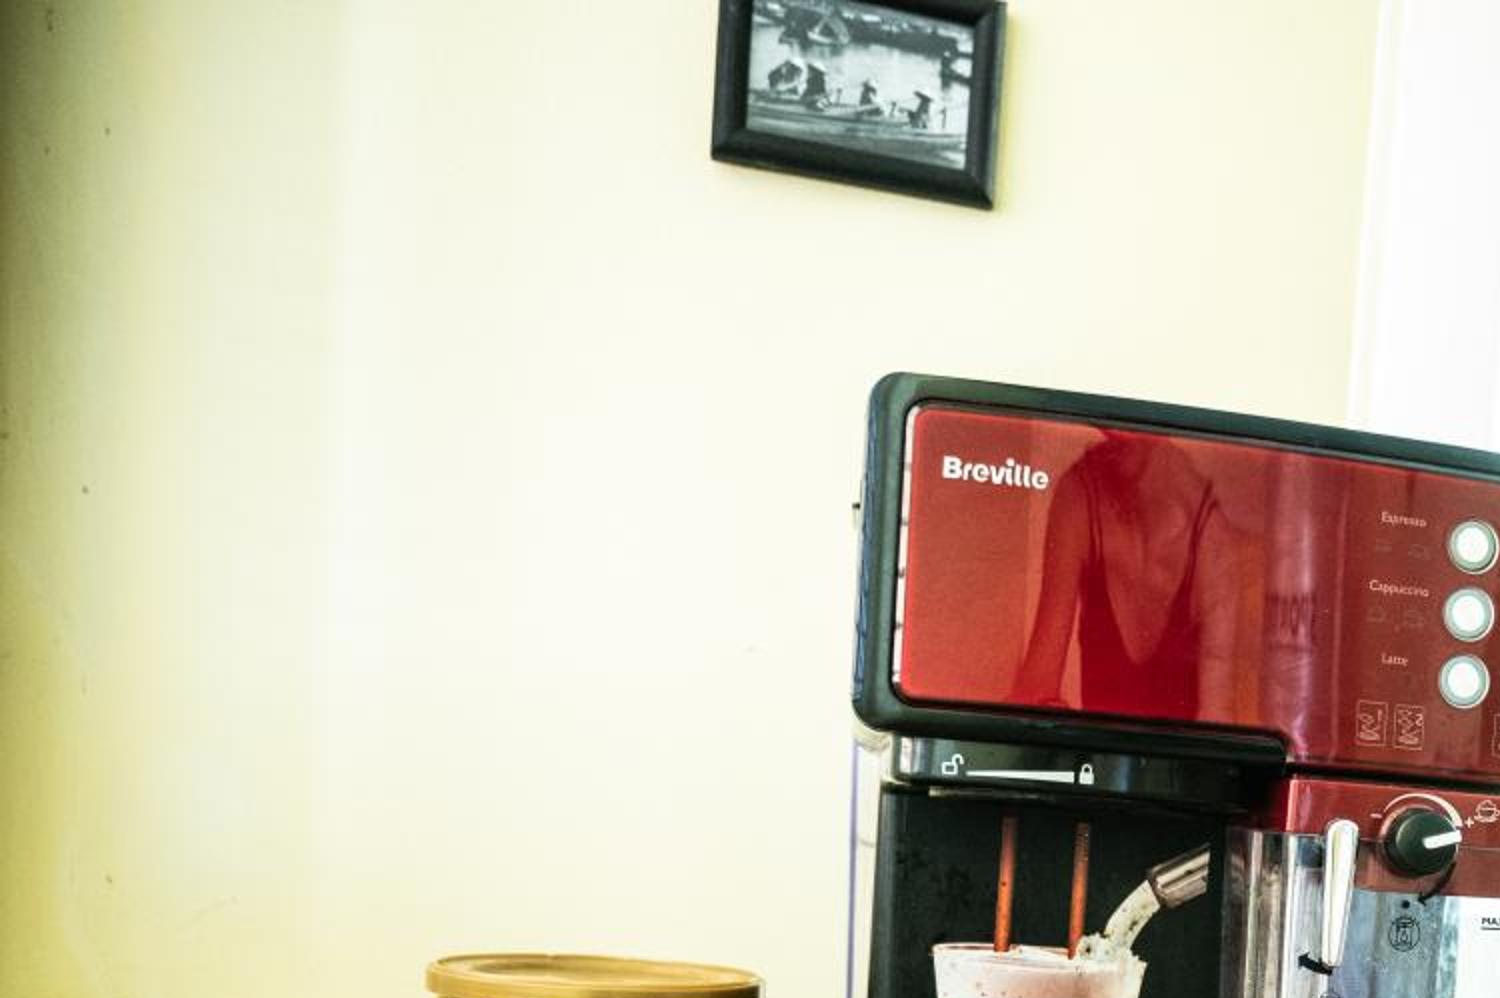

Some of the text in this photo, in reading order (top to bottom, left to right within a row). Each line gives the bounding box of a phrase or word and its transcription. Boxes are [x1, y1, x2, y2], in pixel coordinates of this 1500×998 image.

[943, 455, 1049, 490] Breville
[1381, 511, 1428, 528] Espresso
[1368, 579, 1429, 598] Cappuccino
[1381, 653, 1409, 667] Latte
